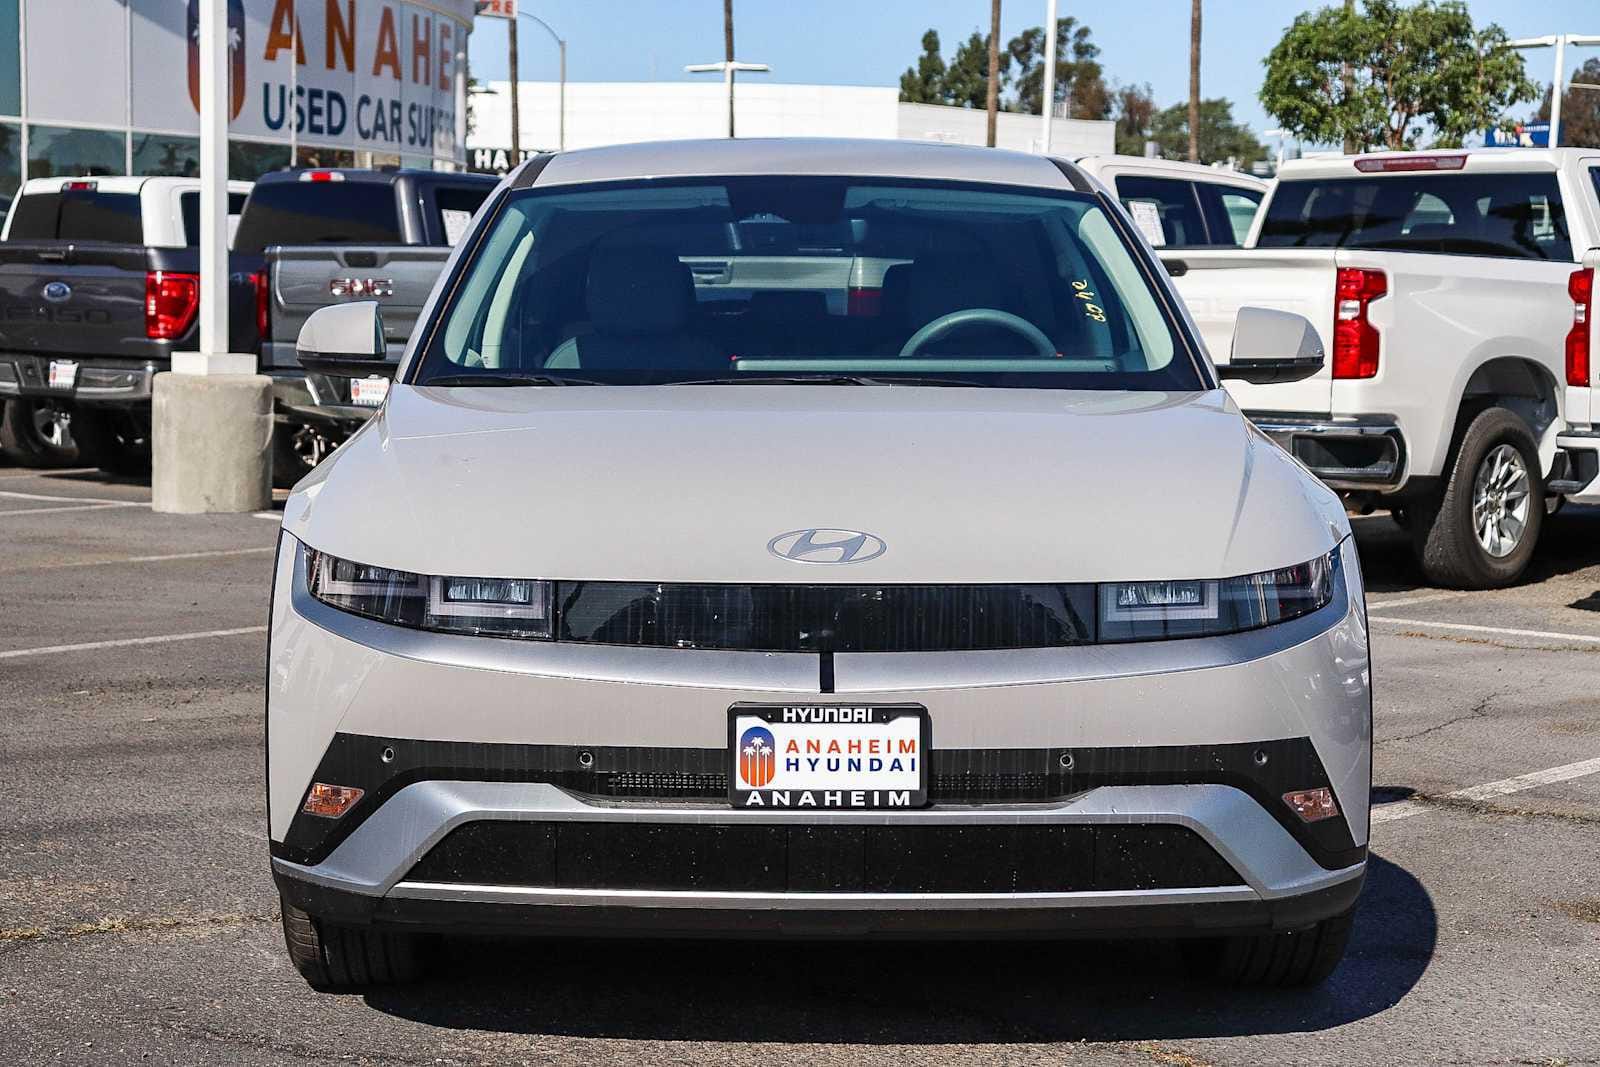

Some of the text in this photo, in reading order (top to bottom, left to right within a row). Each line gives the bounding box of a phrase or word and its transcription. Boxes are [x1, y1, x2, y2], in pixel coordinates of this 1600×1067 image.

[263, 82, 347, 136] USED
[356, 94, 402, 142] CAR
[783, 707, 873, 723] HYUNDAI
[785, 739, 917, 754] ANAHEIM
[785, 758, 917, 772] HYUNDAI
[745, 790, 911, 806] ANAHEIM
